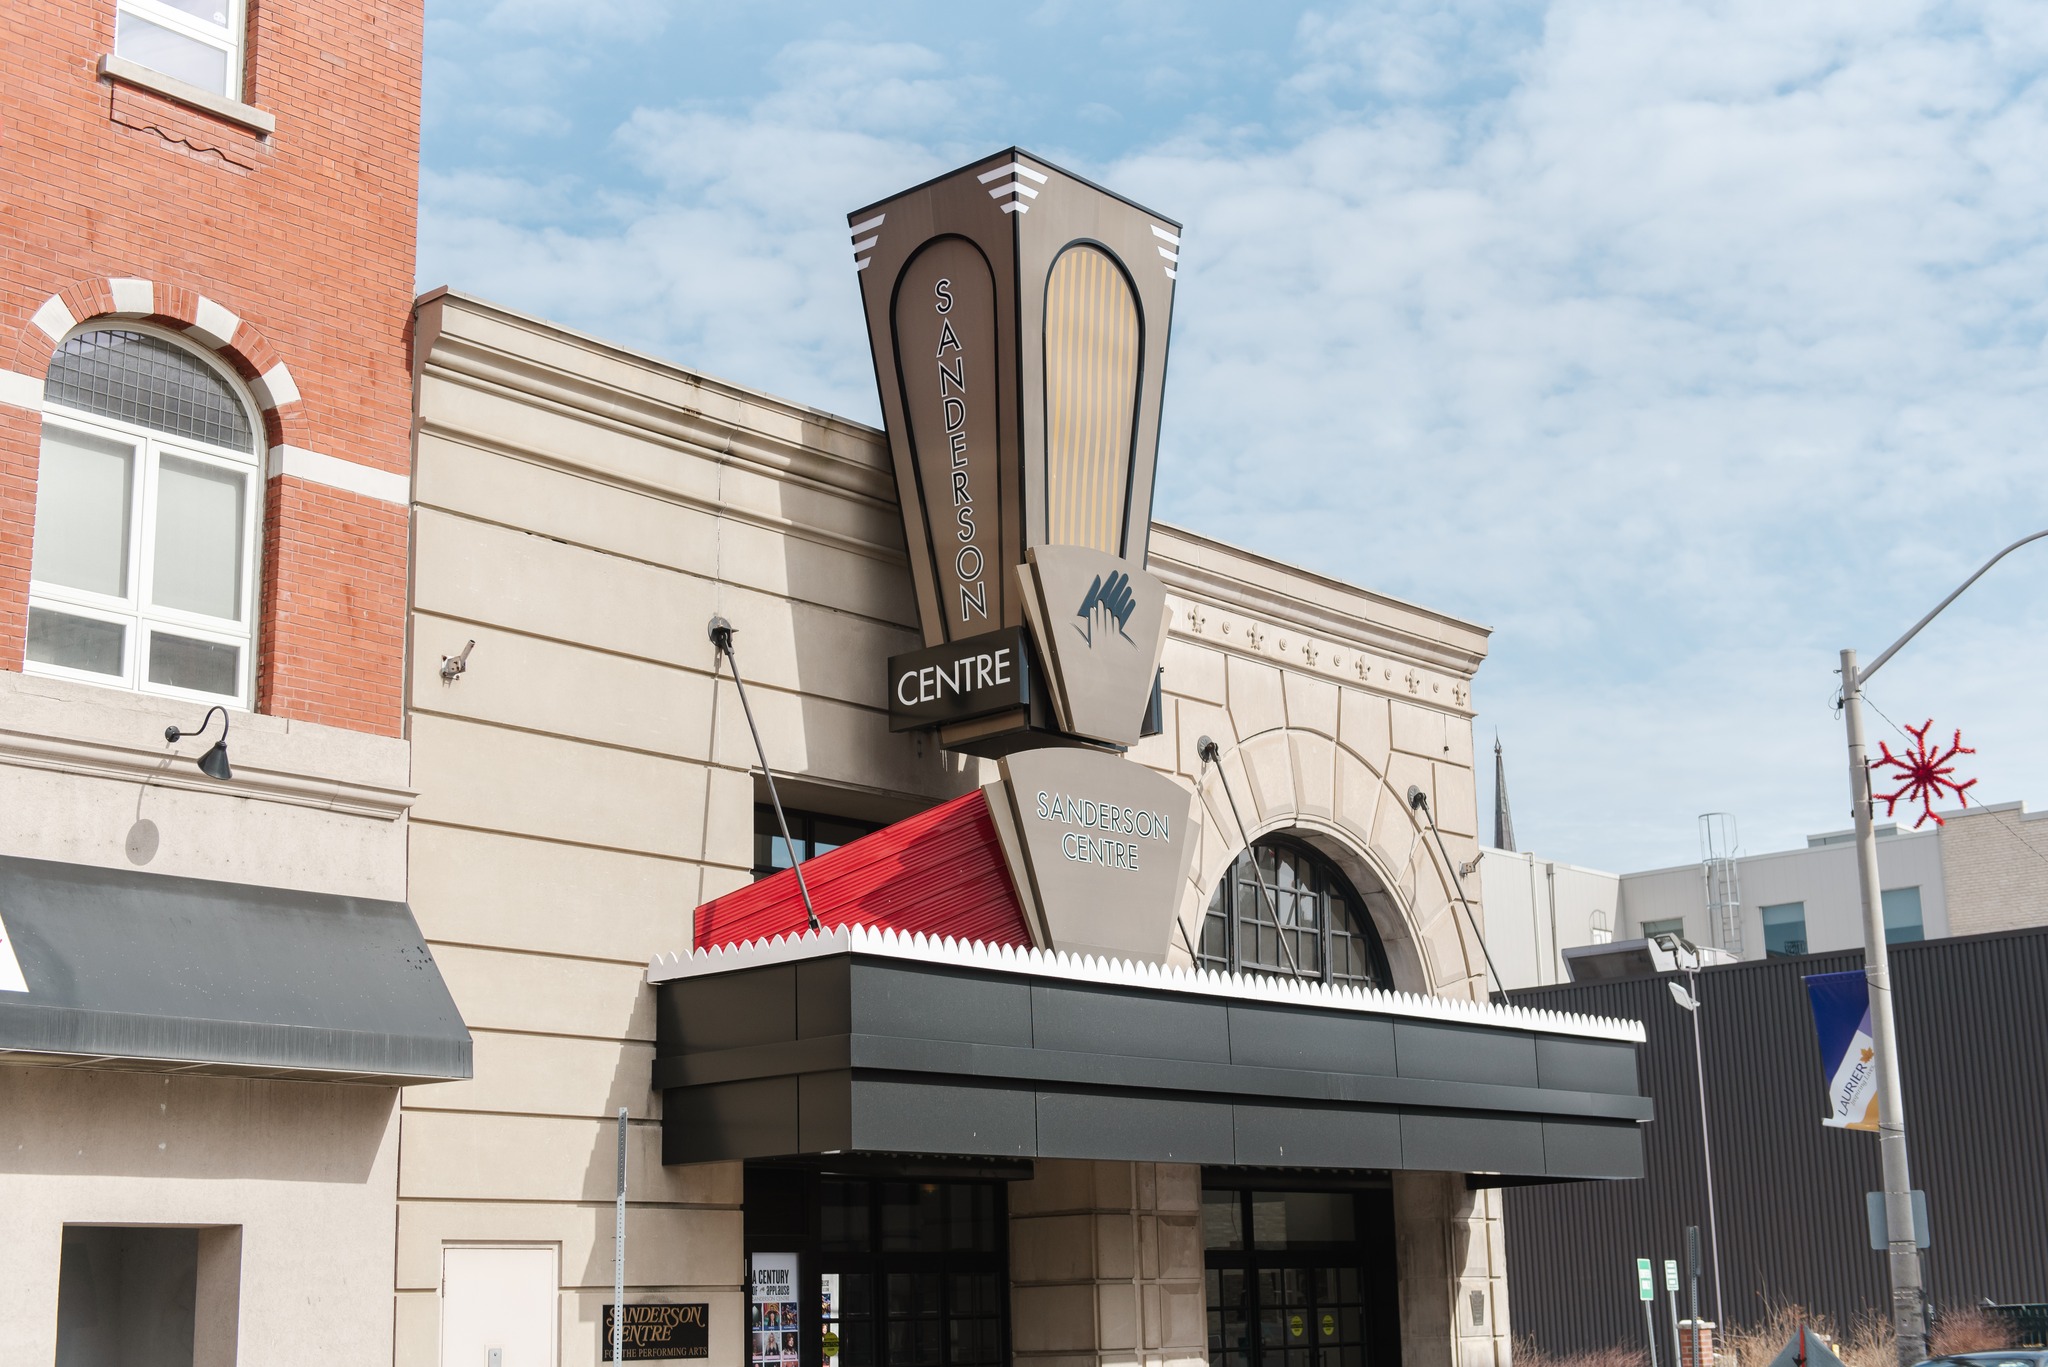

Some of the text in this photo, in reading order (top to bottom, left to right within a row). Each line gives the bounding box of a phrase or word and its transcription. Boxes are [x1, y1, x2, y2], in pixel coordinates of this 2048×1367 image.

[935, 278, 987, 621] SANDERSON
[897, 648, 1011, 706] CENTRE
[1036, 790, 1170, 843] SANDERSON
[1062, 832, 1139, 871] CENTRE
[1838, 1063, 1867, 1116] LAURIER
[752, 1269, 790, 1284] A CENTURY
[604, 1346, 708, 1358] FO THE PERFORMING ARTS
